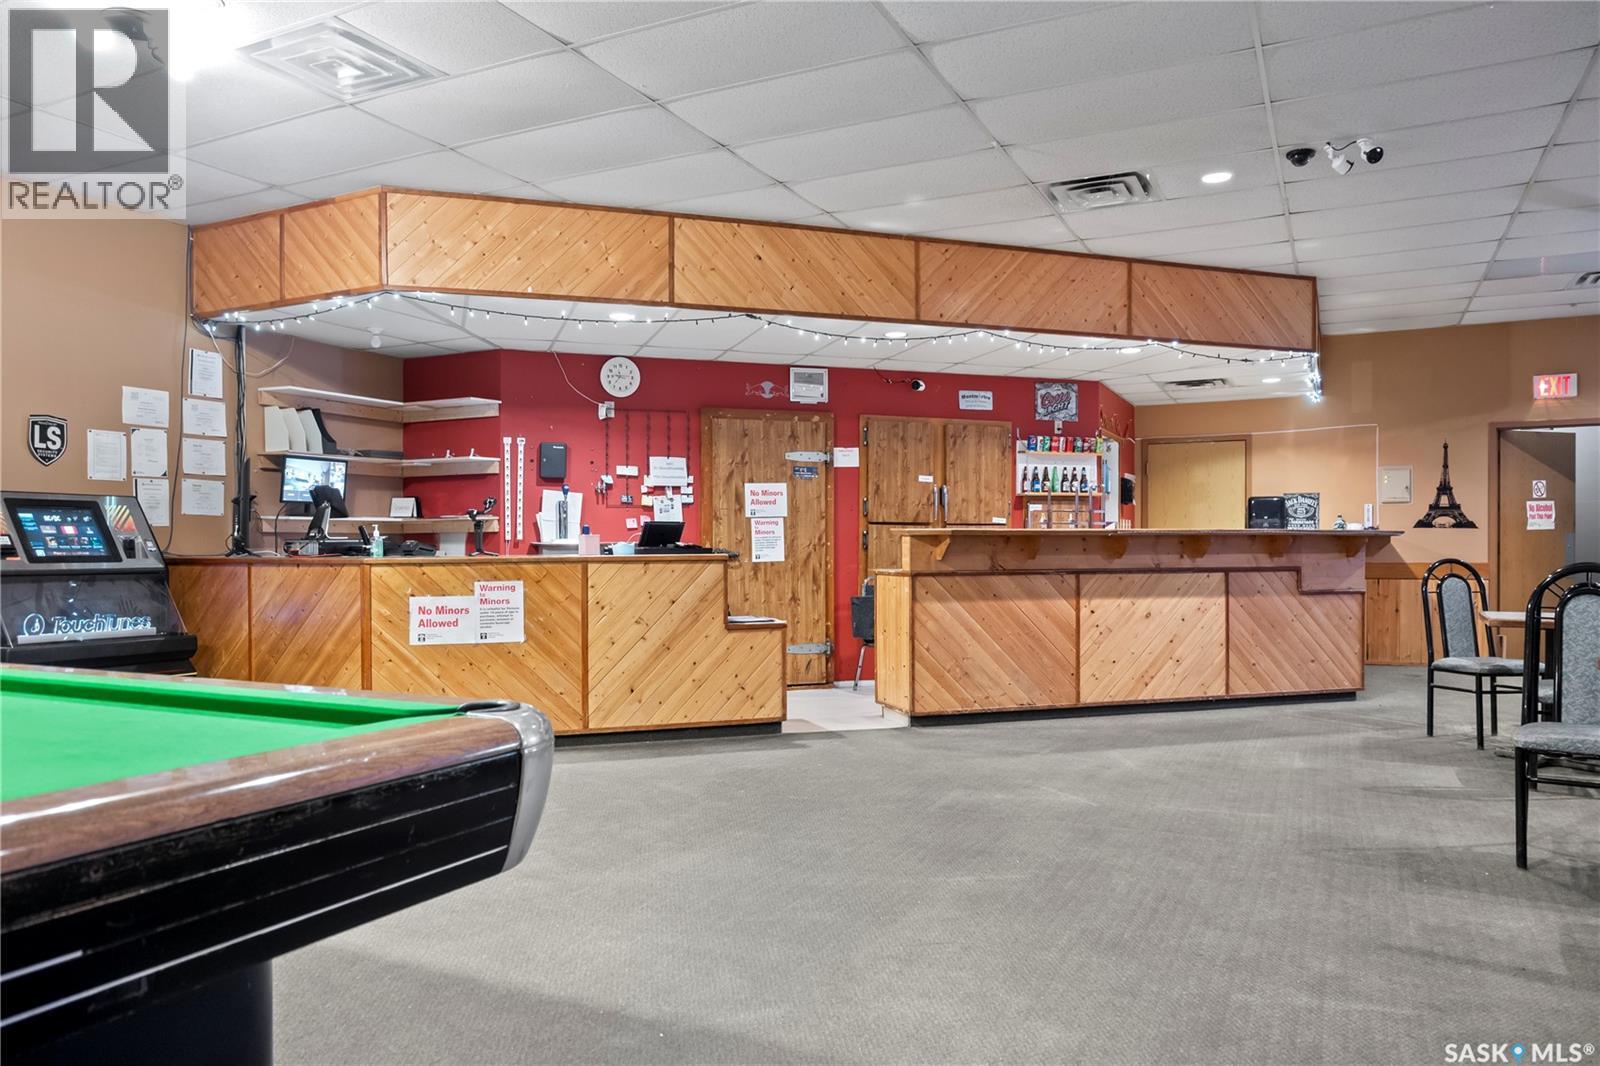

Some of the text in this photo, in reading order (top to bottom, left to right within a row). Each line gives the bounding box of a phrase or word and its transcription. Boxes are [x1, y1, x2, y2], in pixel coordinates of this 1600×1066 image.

[1540, 376, 1570, 396] EXIT
[34, 424, 62, 450] LS
[750, 488, 784, 497] No Minors
[750, 498, 777, 506] Allowed
[479, 584, 516, 592] Warning
[418, 605, 470, 615] No Minors
[418, 618, 459, 628] Allowed
